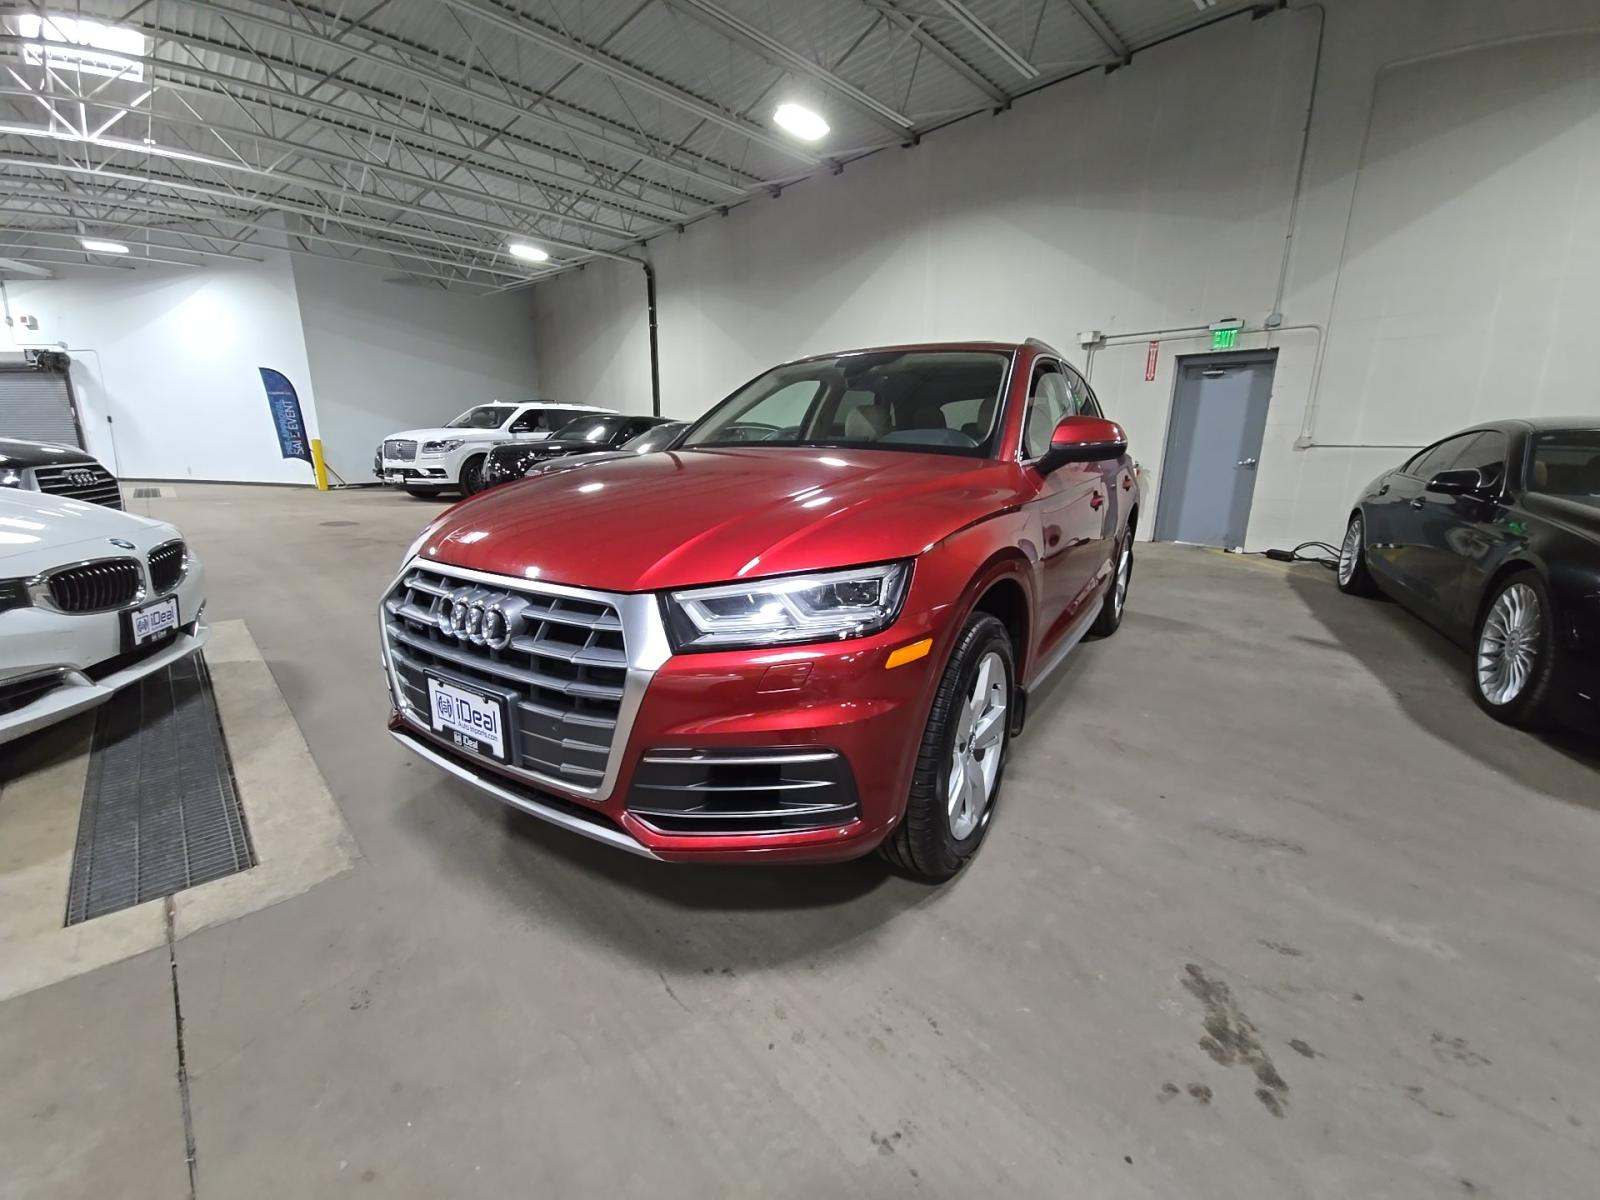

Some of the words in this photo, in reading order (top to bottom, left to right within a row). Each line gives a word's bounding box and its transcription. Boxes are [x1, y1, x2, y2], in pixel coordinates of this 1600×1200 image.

[1213, 329, 1238, 349] EXIT
[283, 400, 299, 430] EVENT
[150, 606, 175, 626] iDeal
[455, 697, 497, 734] iDeal
